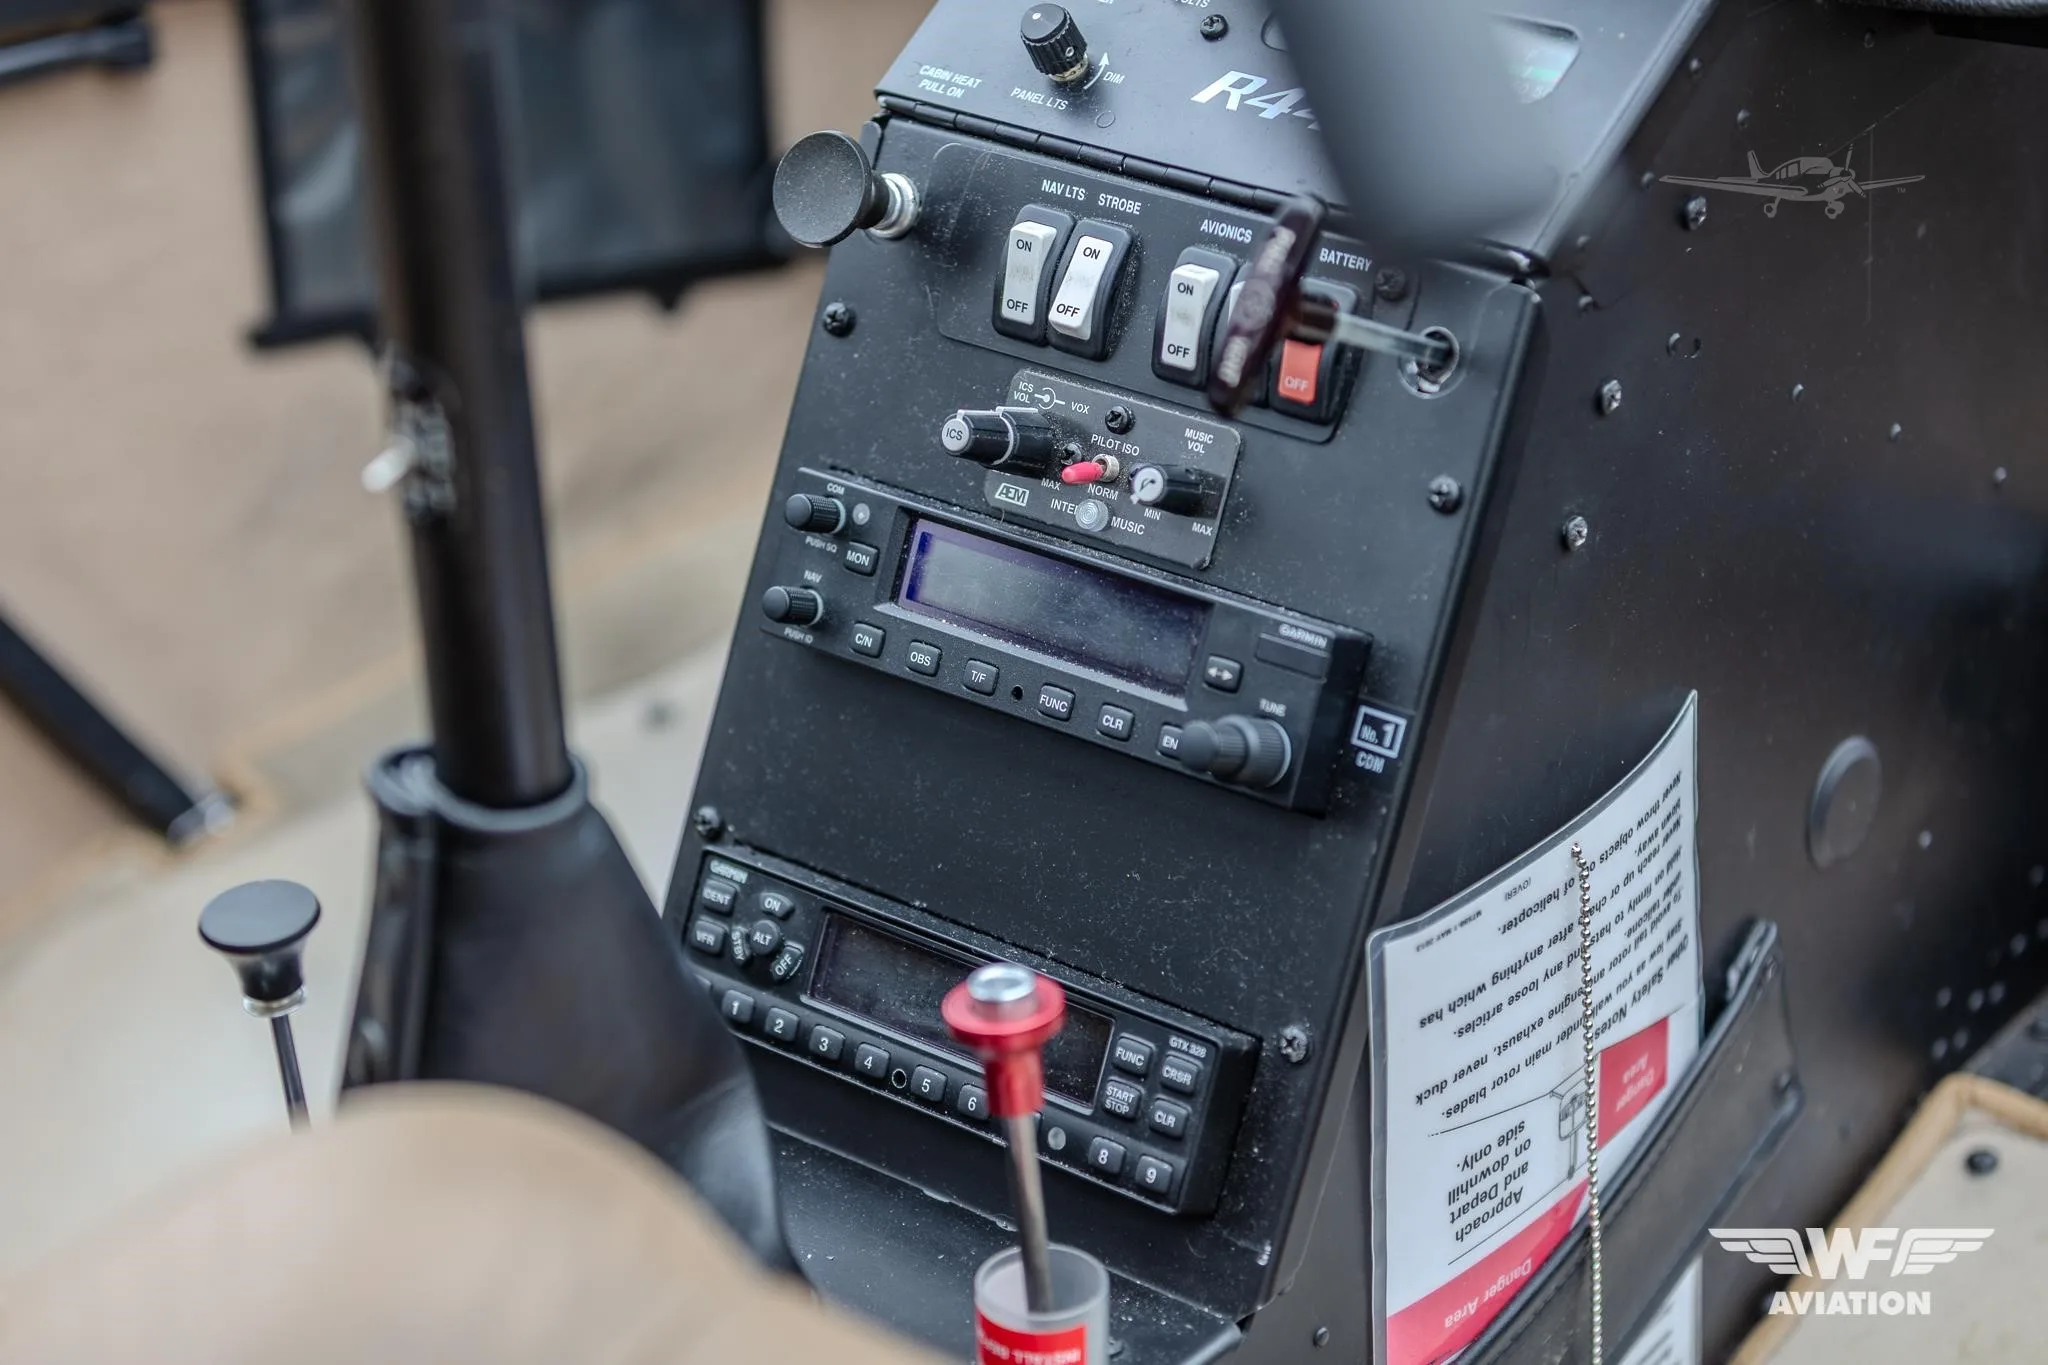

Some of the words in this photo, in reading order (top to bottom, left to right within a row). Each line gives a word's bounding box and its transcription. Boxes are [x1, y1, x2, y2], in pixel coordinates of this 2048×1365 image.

[919, 65, 951, 81] CABIN
[953, 73, 982, 89] HEAT
[1103, 71, 1125, 85] DIM
[918, 79, 945, 94] PULL
[947, 86, 965, 98] ON
[1010, 88, 1045, 105] PANEL
[1046, 97, 1069, 110] LTS
[1041, 179, 1064, 196] NAV
[1065, 185, 1086, 201] LTS
[1098, 193, 1142, 215] STROBE
[1200, 219, 1252, 244] AVIONICS
[1016, 238, 1032, 252] ON
[1083, 246, 1100, 260] ON
[1319, 247, 1372, 272] BATTERY
[1177, 282, 1194, 296] ON
[1006, 298, 1029, 313] OFF
[1056, 303, 1080, 318] OFF
[1167, 343, 1190, 358] OFF
[1018, 381, 1034, 393] ICS
[1284, 375, 1309, 392] OFF
[1013, 391, 1031, 404] VOL
[1070, 401, 1090, 414] VOX
[946, 428, 963, 441] ICS
[1184, 428, 1214, 444] MUSIC
[1091, 434, 1121, 453] PILOT
[1121, 442, 1140, 456] ISO
[1187, 440, 1205, 454] VOL
[826, 482, 845, 495] COM
[1041, 478, 1061, 491] MAX
[1087, 483, 1119, 501] NORM
[1144, 508, 1161, 521] MIN
[1111, 516, 1145, 535] MUSIC
[1192, 522, 1213, 536] MAX
[805, 535, 825, 549] PUSH
[846, 550, 870, 567] MON
[804, 570, 822, 583] NAV
[855, 633, 873, 648] C/N
[1278, 623, 1328, 648] GARMIN
[910, 651, 931, 667] OBS
[971, 670, 987, 683] T/F
[1039, 694, 1068, 713] FUNC
[1259, 698, 1287, 718] TUNE
[1102, 715, 1124, 731] CLR
[1162, 735, 1179, 751] EN
[1361, 724, 1379, 744] No.
[1382, 723, 1394, 748] 1
[1355, 751, 1385, 774] COM
[1636, 799, 1660, 830] throw
[1599, 828, 1633, 864] objects
[1635, 827, 1659, 857] away.
[1637, 844, 1660, 873] reach
[709, 860, 749, 884] GARMIN
[1623, 870, 1635, 887] up
[1654, 870, 1664, 885] on
[1563, 877, 1575, 896] of
[1610, 884, 1620, 899] or
[764, 897, 781, 912] ON
[1627, 883, 1652, 914] firmly
[1498, 888, 1560, 935] helicopter.
[1614, 910, 1624, 925] to
[1624, 900, 1660, 939] tailcone.
[1650, 901, 1671, 934] avoid
[695, 929, 715, 946] VFR
[753, 931, 772, 946] ALT
[1547, 922, 1574, 948] after
[1590, 922, 1611, 947] hats
[1634, 929, 1648, 950] tail
[731, 931, 745, 961] STBY
[1567, 945, 1588, 964] nd
[1649, 942, 1664, 961] low
[774, 954, 793, 976] OFF
[1491, 944, 1544, 987] anything
[1608, 944, 1631, 972] rotor
[1636, 959, 1646, 976] as
[1542, 961, 1563, 982] any
[1508, 979, 1539, 1006] loose
[1616, 972, 1633, 995] you
[1631, 967, 1664, 1007] Safety
[1448, 982, 1487, 1014] which
[731, 1001, 739, 1016] 1
[773, 1019, 784, 1034] 2
[1419, 1008, 1443, 1029] has
[1453, 1002, 1503, 1038] articles.
[819, 1036, 829, 1051] 3
[1169, 1036, 1189, 1052] GTX
[1493, 1016, 1544, 1056] exhaust,
[864, 1056, 873, 1070] 4
[1115, 1047, 1145, 1067] FUNC
[1525, 1041, 1552, 1067] main
[1162, 1065, 1192, 1086] CRSR
[1452, 1054, 1488, 1084] never
[1491, 1063, 1521, 1091] rotor
[921, 1078, 931, 1093] 5
[1105, 1086, 1135, 1104] START
[1415, 1079, 1448, 1106] duck
[968, 1096, 977, 1111] 6
[1105, 1099, 1129, 1115] STOP
[1441, 1086, 1487, 1119] blades.
[1154, 1111, 1176, 1128] CLR
[1498, 1121, 1525, 1147] side
[1515, 1139, 1531, 1156] on
[1098, 1150, 1108, 1165] 8
[1457, 1144, 1492, 1172] only.
[1145, 1168, 1157, 1184] 9
[1448, 1154, 1509, 1206] downhill
[1504, 1162, 1529, 1190] and
[1449, 1183, 1498, 1224] Depart
[1455, 1186, 1524, 1242] Approach
[1483, 1257, 1532, 1303] Danger
[1444, 1297, 1479, 1328] Area
